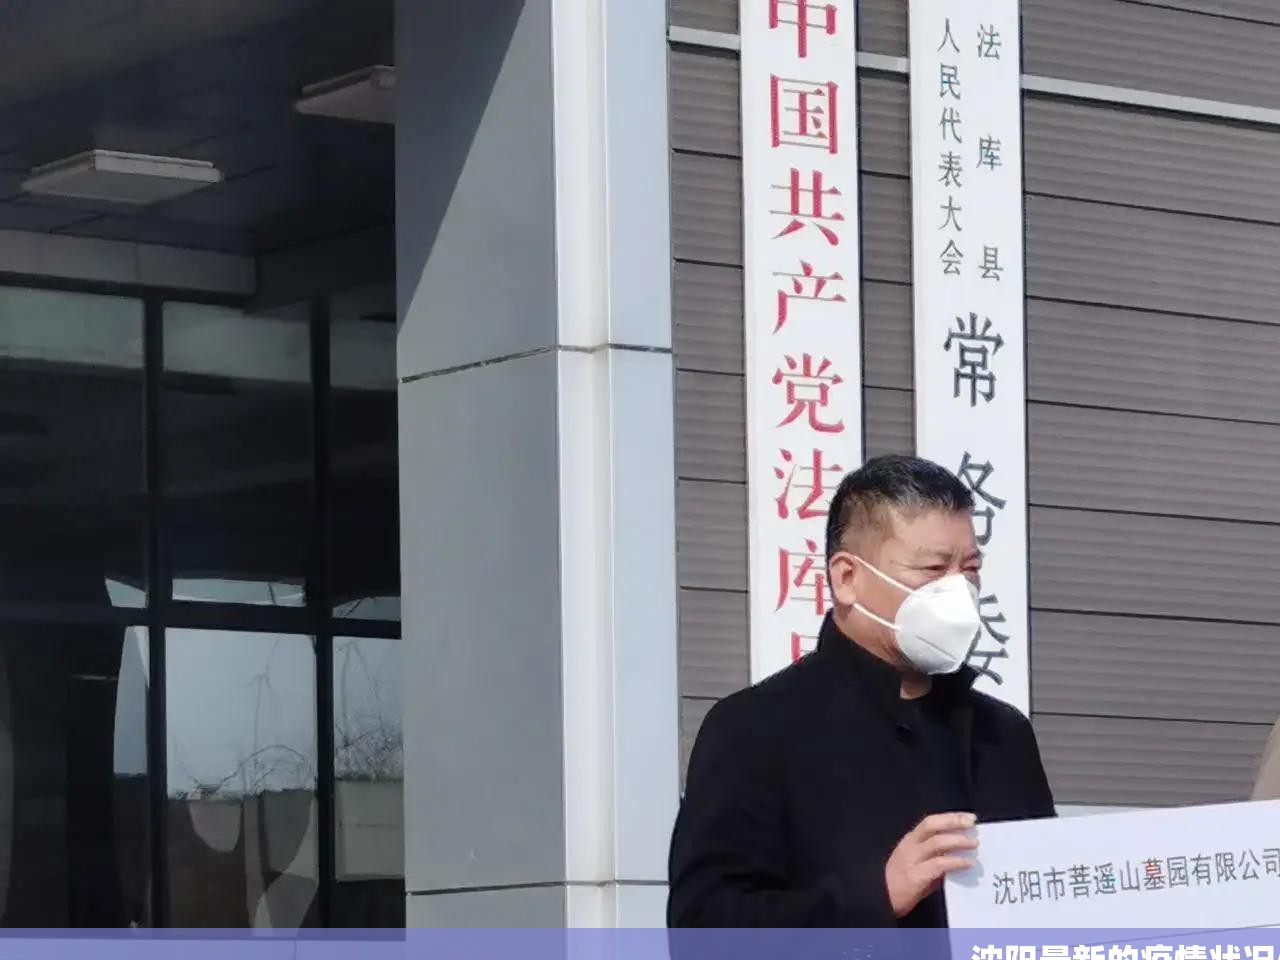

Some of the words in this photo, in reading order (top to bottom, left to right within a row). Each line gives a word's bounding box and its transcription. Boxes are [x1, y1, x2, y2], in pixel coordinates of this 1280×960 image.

[937, 18, 963, 277] 人民代表大会
[976, 24, 1004, 281] 法库县
[768, 0, 847, 664] 中国共产党法库
